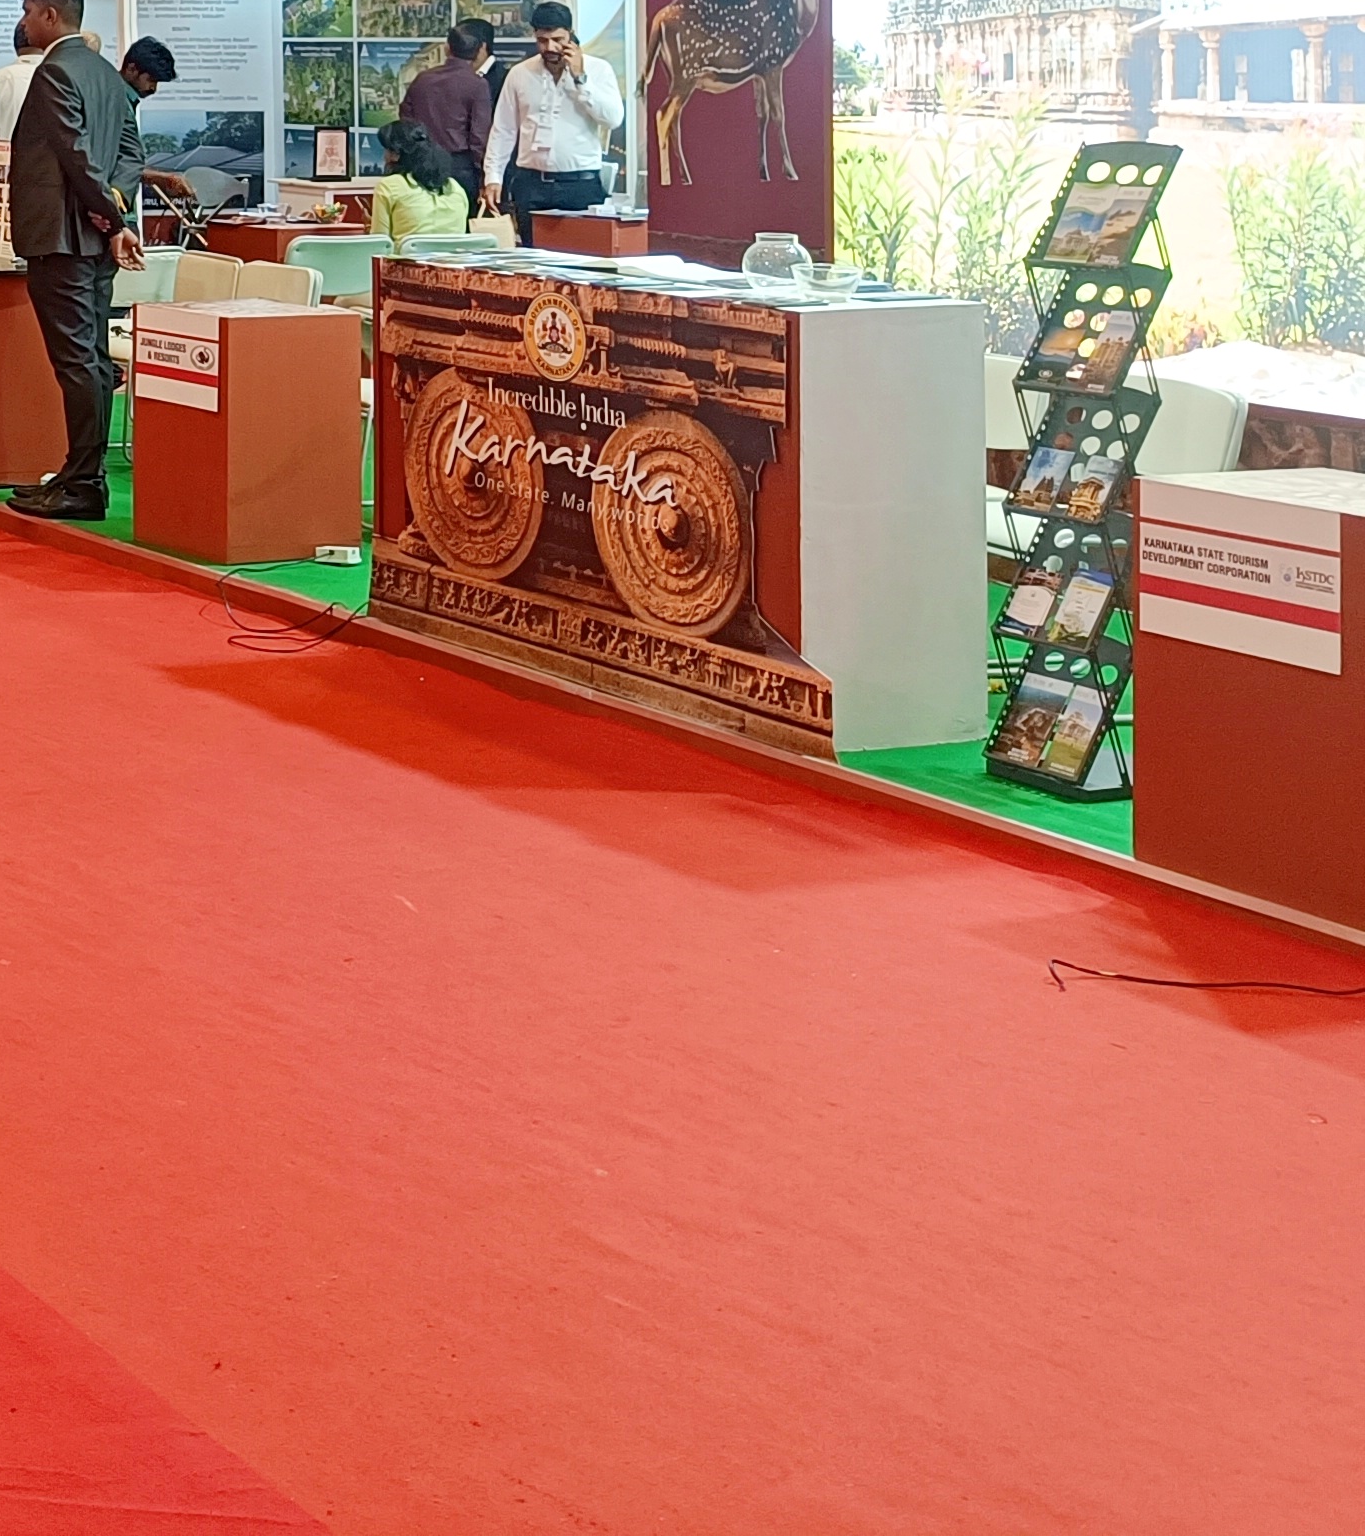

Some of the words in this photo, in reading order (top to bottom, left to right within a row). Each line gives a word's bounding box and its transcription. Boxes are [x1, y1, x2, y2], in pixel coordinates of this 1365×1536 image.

[528, 298, 573, 326] GOVERNMENT
[140, 337, 163, 349] JUNGLE
[163, 340, 187, 353] LODGES
[153, 351, 180, 365] RESORTS
[535, 356, 575, 376] KARNATAKA
[487, 376, 577, 420] Incredible
[444, 398, 679, 508] Karnataka
[474, 471, 505, 493] One
[560, 491, 609, 521] Many
[1142, 549, 1204, 571] DEVELOPMENT
[1207, 562, 1271, 584] CORPORATION
[1144, 537, 1195, 556] KARNATAKA
[1197, 547, 1224, 562] STATE
[1227, 552, 1269, 570] TOURISM
